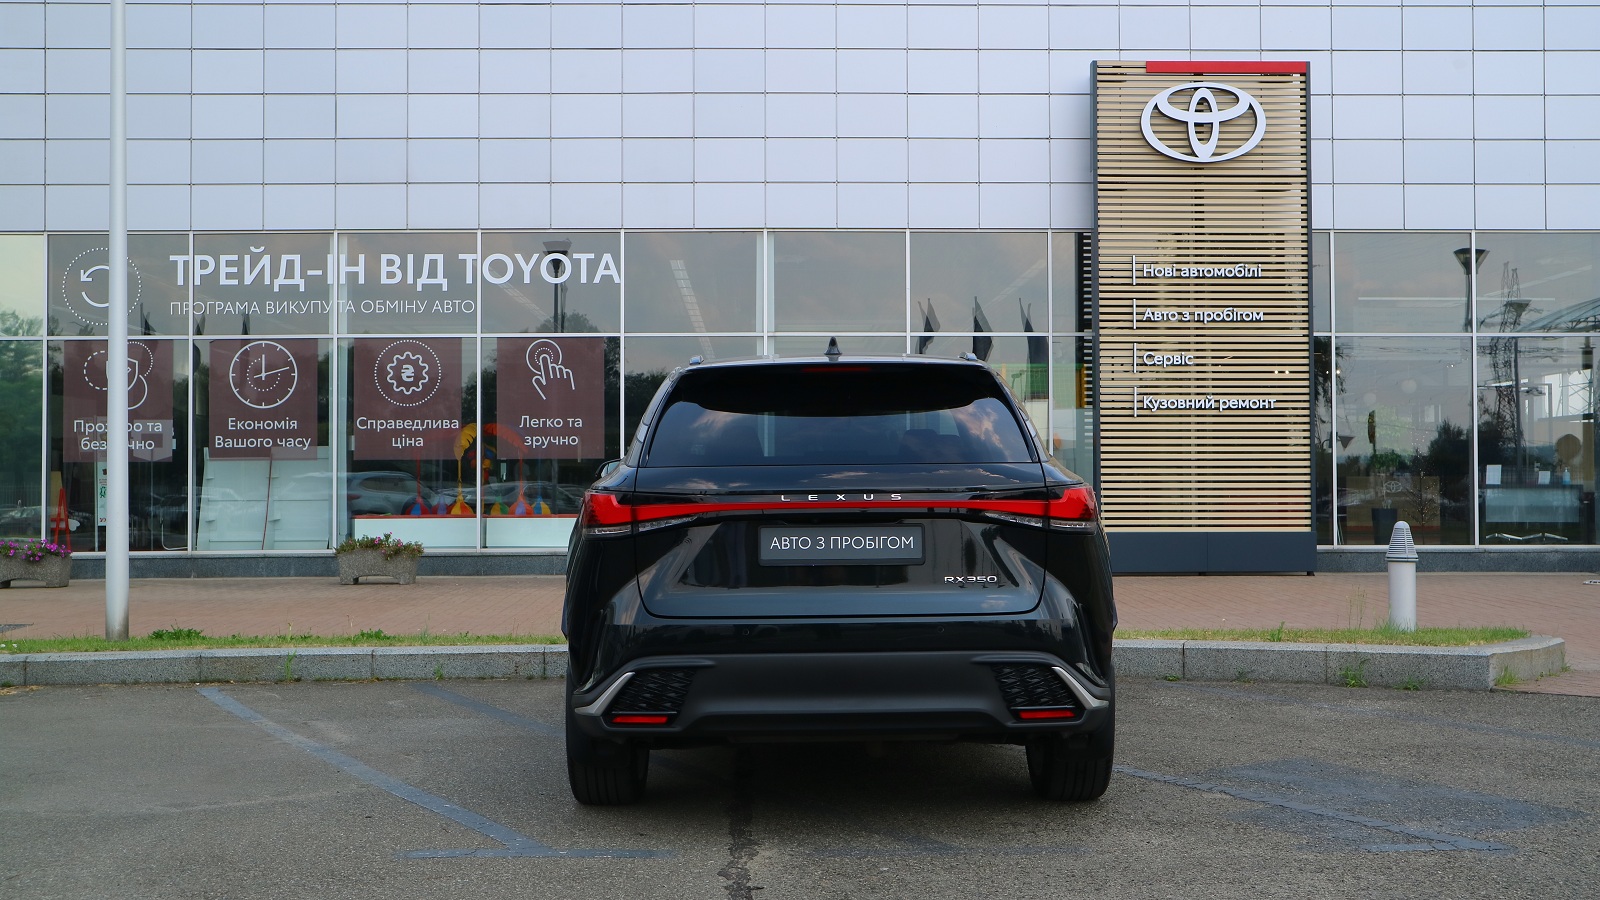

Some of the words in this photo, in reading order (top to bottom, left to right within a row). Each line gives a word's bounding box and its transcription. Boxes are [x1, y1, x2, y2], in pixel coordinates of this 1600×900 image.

[169, 246, 365, 292] ТРЕЙД-ІН
[380, 253, 448, 291] ВІД
[458, 252, 621, 285] TOYOTA
[1143, 263, 1176, 278] Нові
[1180, 263, 1262, 278] автомобілі
[170, 301, 261, 315] ПРОГРАМА
[265, 300, 333, 314] ВИКУПУ
[336, 300, 356, 313] ТА
[360, 299, 428, 314] ОБМІНУ
[431, 299, 475, 314] АВТО
[1142, 308, 1178, 321] Авто
[1181, 311, 1190, 321] з
[1194, 307, 1264, 324] пробігом
[1143, 352, 1194, 368] Сервіс
[1143, 395, 1215, 412] Кузовний
[1219, 398, 1277, 412] ремонт
[74, 419, 143, 436] Проо
[146, 422, 163, 432] та
[228, 417, 298, 430] Економія
[356, 416, 460, 433] Справедлива
[519, 415, 564, 428] Легко
[567, 418, 583, 428] та
[81, 436, 155, 451] безчно
[215, 435, 273, 448] Вашого
[277, 437, 312, 451] часу
[392, 434, 424, 449] ціна
[524, 435, 579, 449] зручно
[781, 493, 902, 502] LEXUS
[770, 536, 812, 550] АВТО
[816, 536, 826, 549] З
[830, 536, 914, 549] ПРОБІГОМ
[944, 575, 998, 584] RX350
